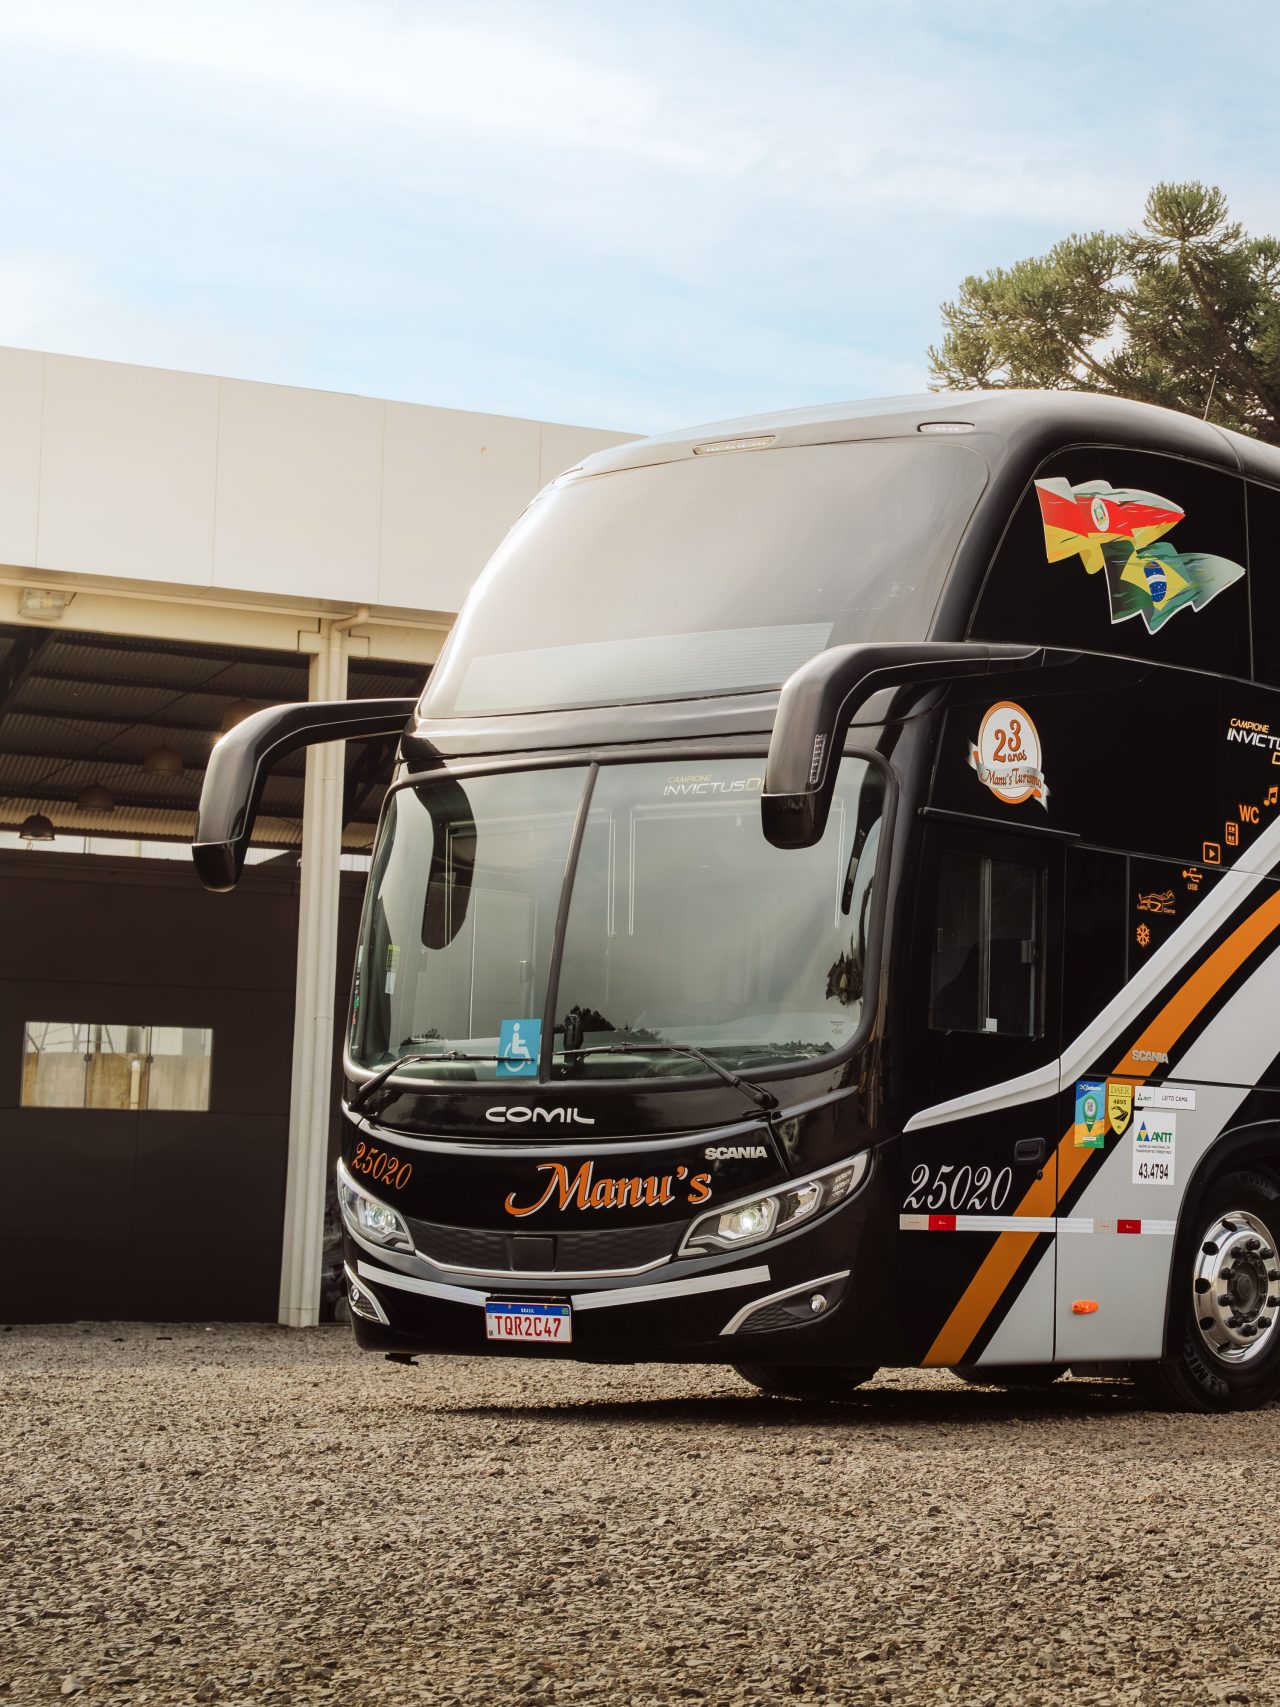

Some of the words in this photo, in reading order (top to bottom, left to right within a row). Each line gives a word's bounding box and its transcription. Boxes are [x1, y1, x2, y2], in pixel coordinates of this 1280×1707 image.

[1230, 718, 1270, 733] CAMPIONE
[993, 719, 1021, 763] 23
[1007, 749, 1028, 762] anos
[667, 774, 713, 784] CAMPIONE
[1011, 767, 1042, 789] Turismo
[663, 780, 746, 796] INVICTUS
[1239, 804, 1260, 824] WC
[1131, 1049, 1169, 1064] SCANIA
[485, 1106, 595, 1125] COMIL
[1150, 1131, 1173, 1143] ANTT
[704, 1146, 768, 1161] SCANIA
[351, 1141, 413, 1190] 25020
[1138, 1163, 1169, 1179] 43.4794
[504, 1160, 713, 1218] Manu's
[902, 1164, 1013, 1211] 25020
[494, 1315, 562, 1338] TQR2C47
